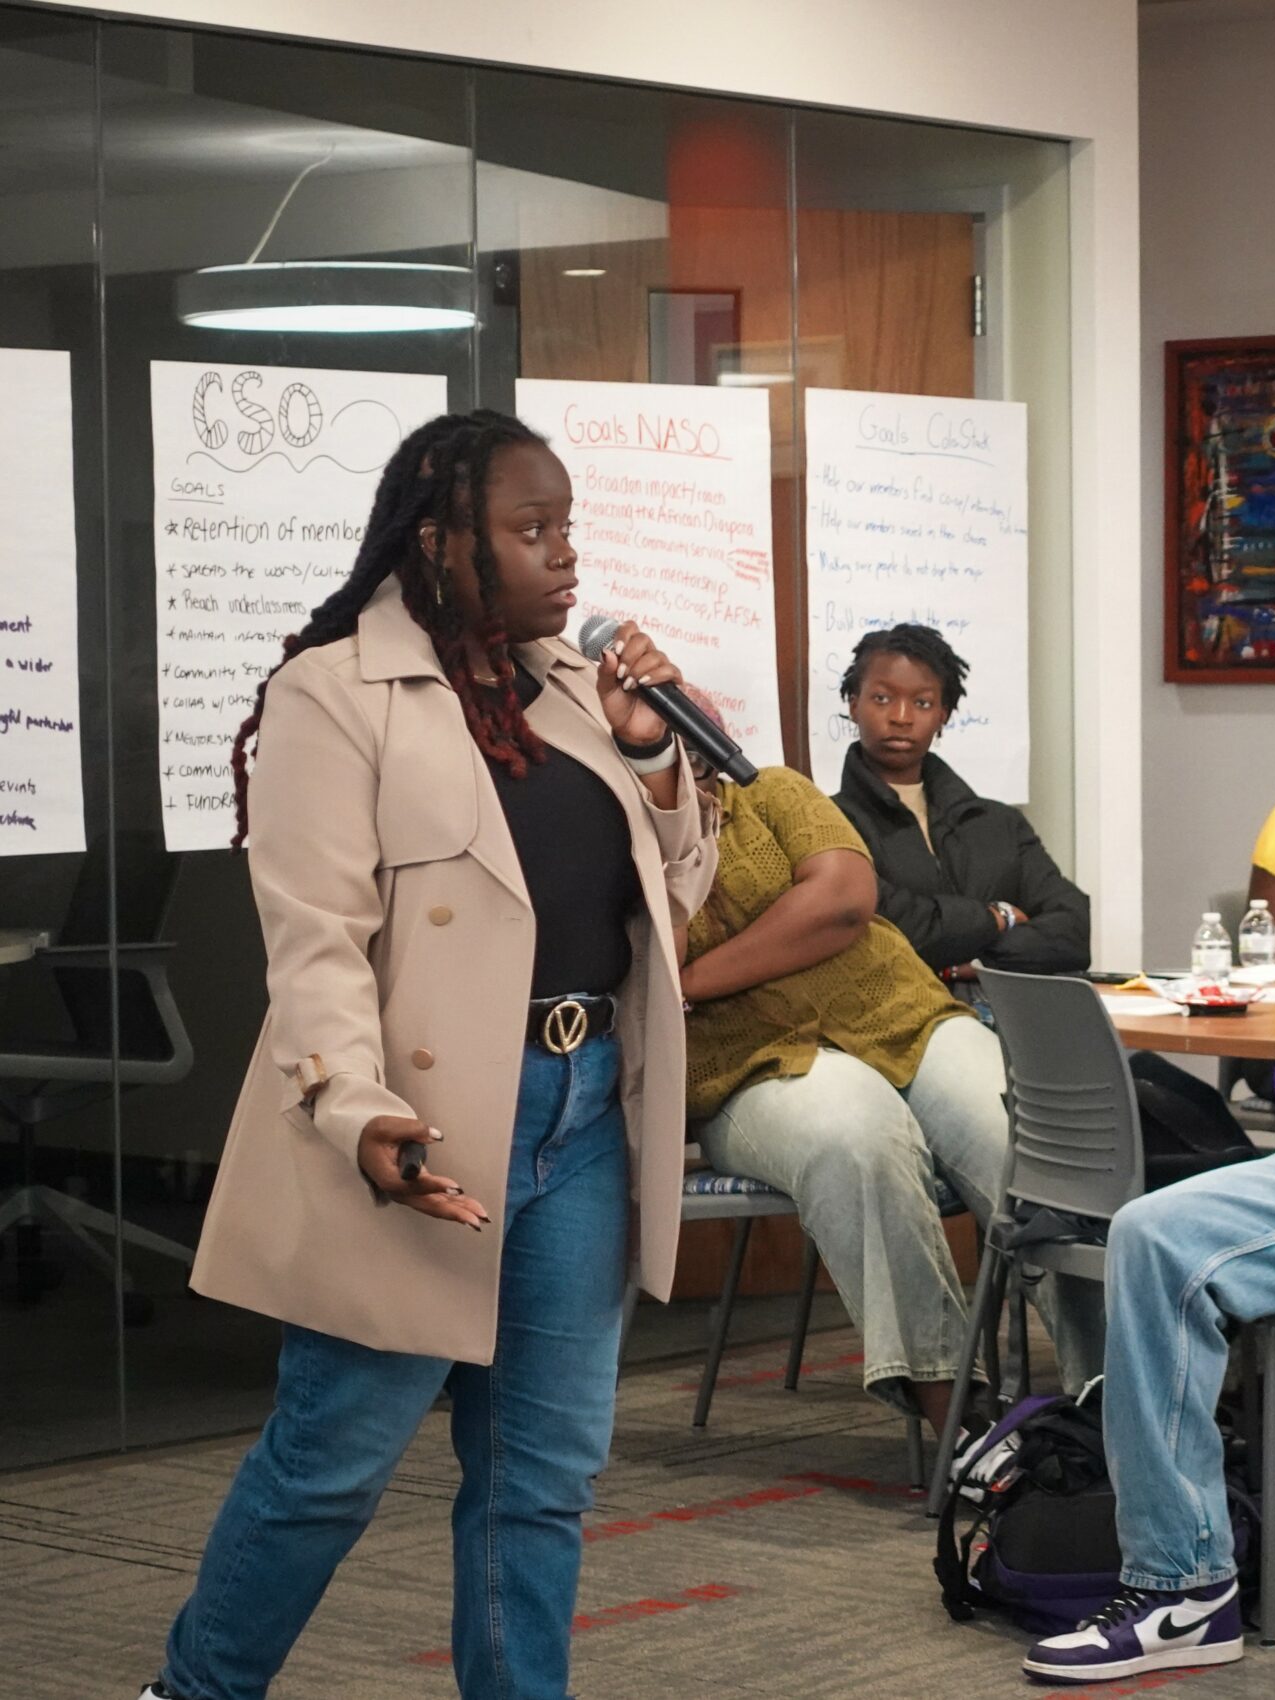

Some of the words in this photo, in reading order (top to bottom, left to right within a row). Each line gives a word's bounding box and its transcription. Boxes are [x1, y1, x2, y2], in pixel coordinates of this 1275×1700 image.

[192, 371, 323, 455] CSO
[564, 403, 629, 444] Goals
[637, 413, 720, 456] NASO
[859, 404, 909, 446] Goals
[170, 477, 224, 497] GOALS
[184, 514, 269, 544] Retention
[278, 516, 297, 542] of
